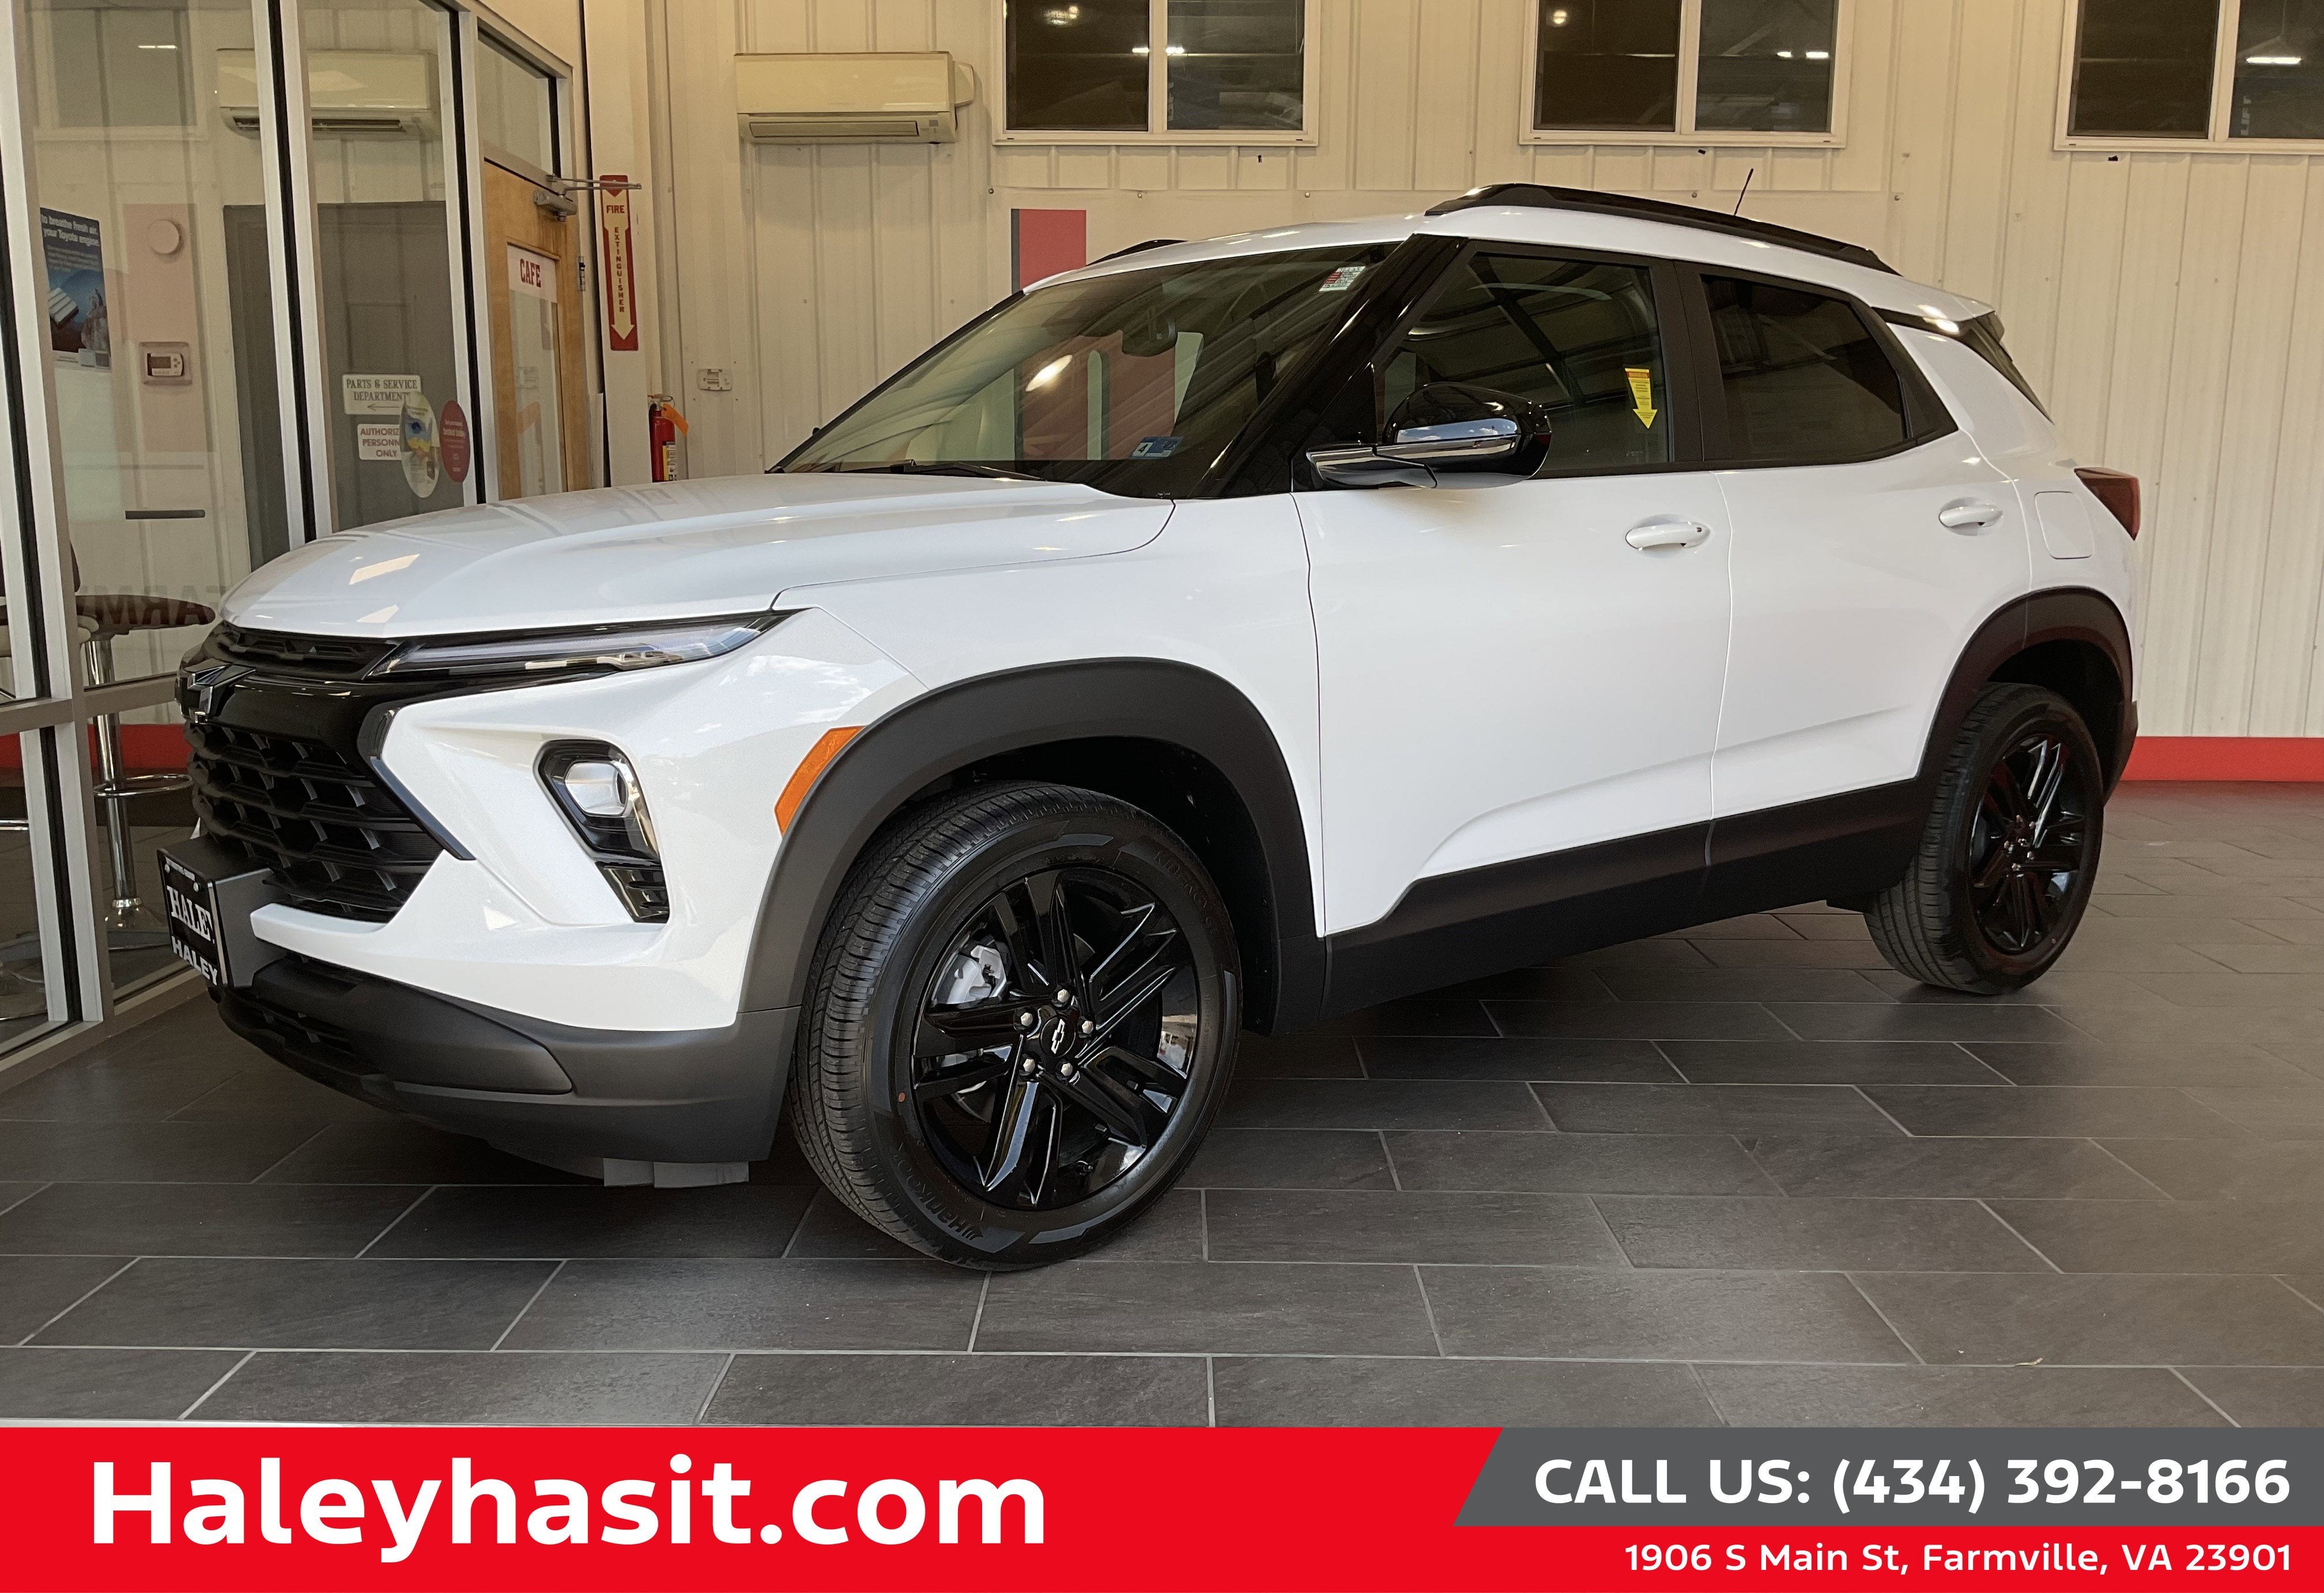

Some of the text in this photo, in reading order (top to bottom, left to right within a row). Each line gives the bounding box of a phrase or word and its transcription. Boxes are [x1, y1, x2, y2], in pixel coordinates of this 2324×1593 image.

[606, 205, 625, 214] FIRE
[520, 259, 541, 288] CAFE
[614, 227, 624, 312] EXTINGUISHER
[346, 379, 417, 389] PARTS & SERVICE
[363, 439, 400, 447] PERSONN
[172, 935, 218, 986] HALEY
